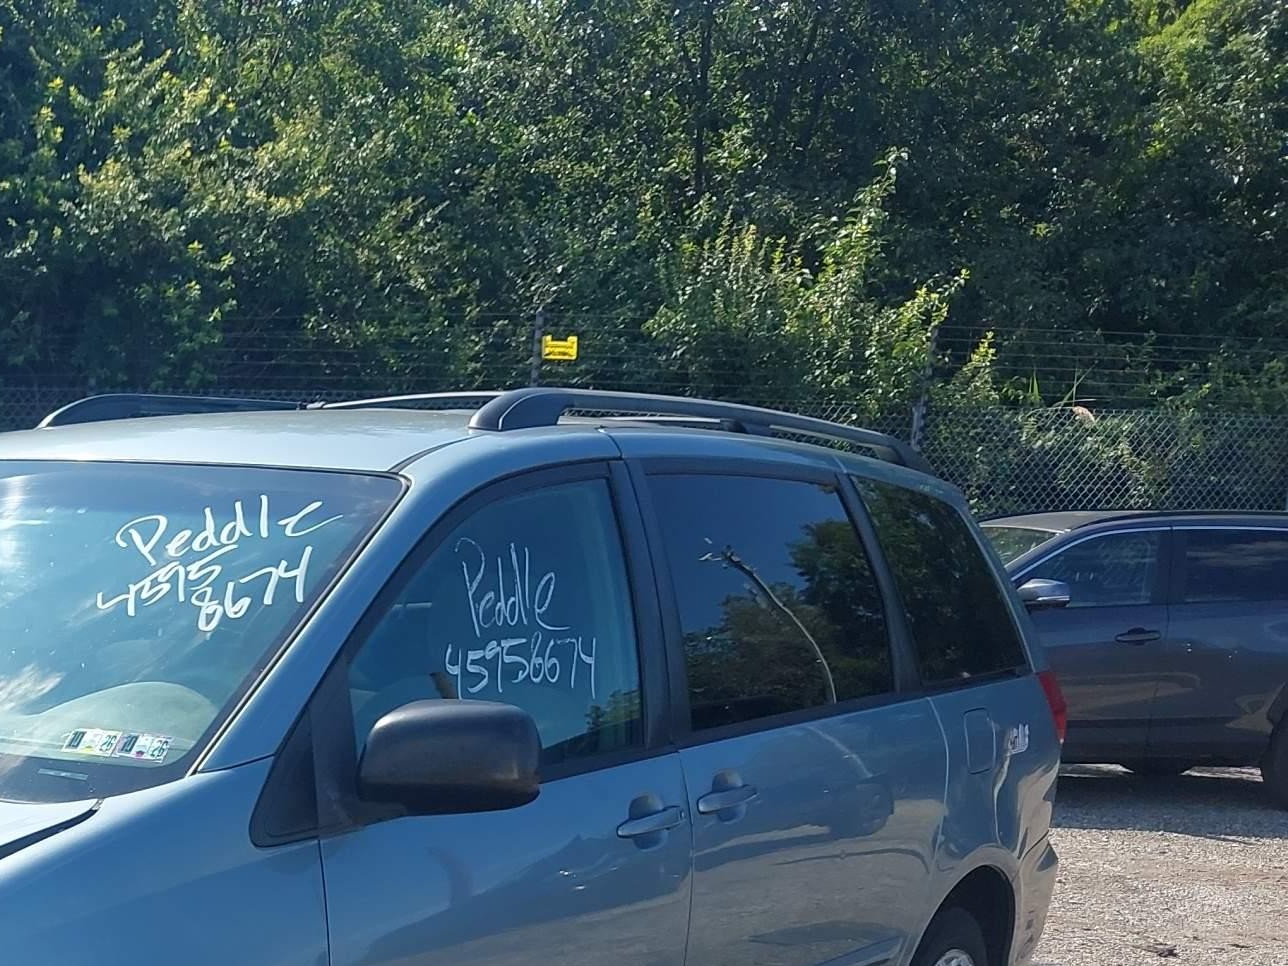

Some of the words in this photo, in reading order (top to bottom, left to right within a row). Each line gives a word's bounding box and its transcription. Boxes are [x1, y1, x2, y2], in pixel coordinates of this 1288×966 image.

[96, 545, 239, 616] 4595
[190, 546, 312, 632] 8674
[455, 537, 571, 637] Peddle
[445, 631, 596, 700] 45958674
